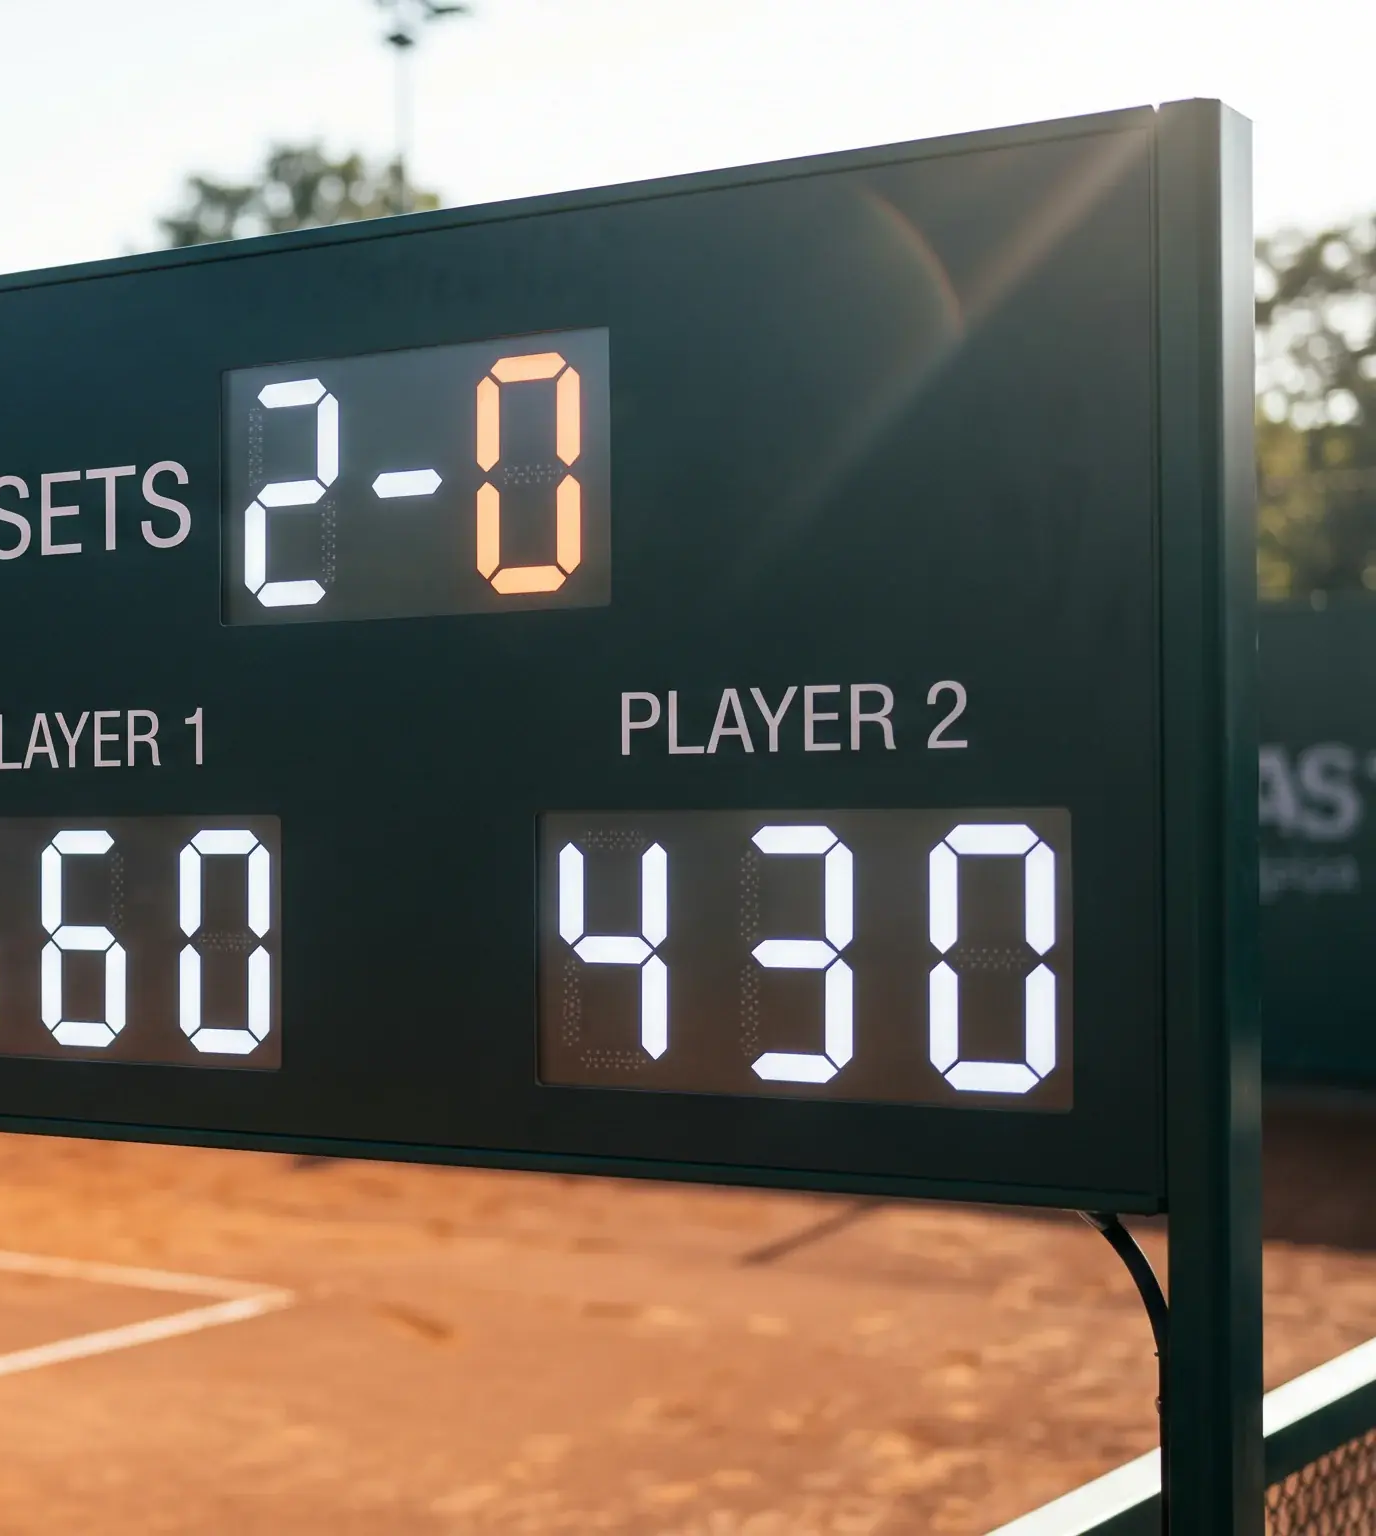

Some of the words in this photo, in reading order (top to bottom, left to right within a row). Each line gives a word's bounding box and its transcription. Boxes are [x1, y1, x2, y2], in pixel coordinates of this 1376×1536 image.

[184, 707, 203, 765] 1
[621, 683, 897, 756] PLAYER
[926, 679, 969, 749] 2
